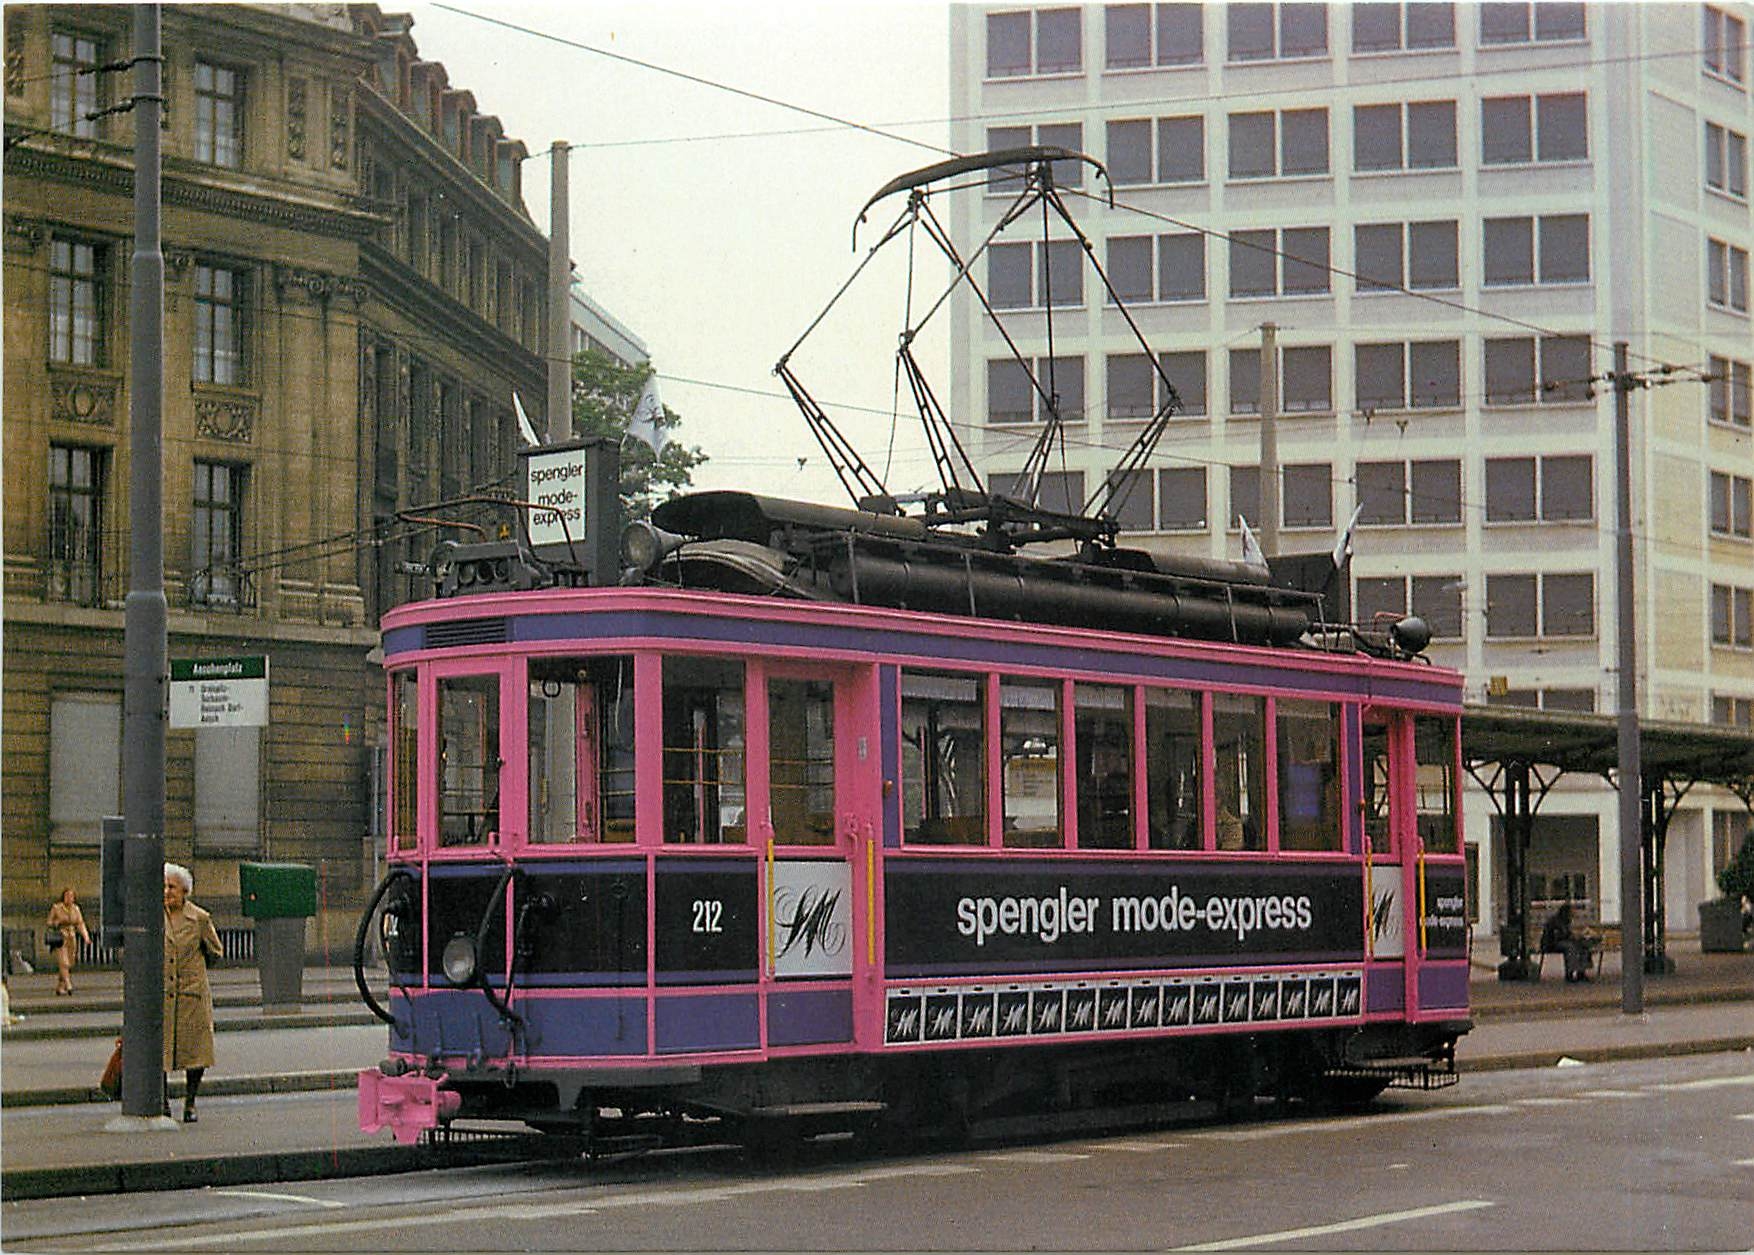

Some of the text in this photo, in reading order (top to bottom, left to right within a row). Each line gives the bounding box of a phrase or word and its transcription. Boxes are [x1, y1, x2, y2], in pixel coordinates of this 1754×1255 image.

[531, 462, 583, 486] spengler
[538, 488, 578, 505] mode-
[533, 508, 580, 527] express
[692, 900, 723, 932] 212
[957, 885, 1312, 945] spengler mode-express
